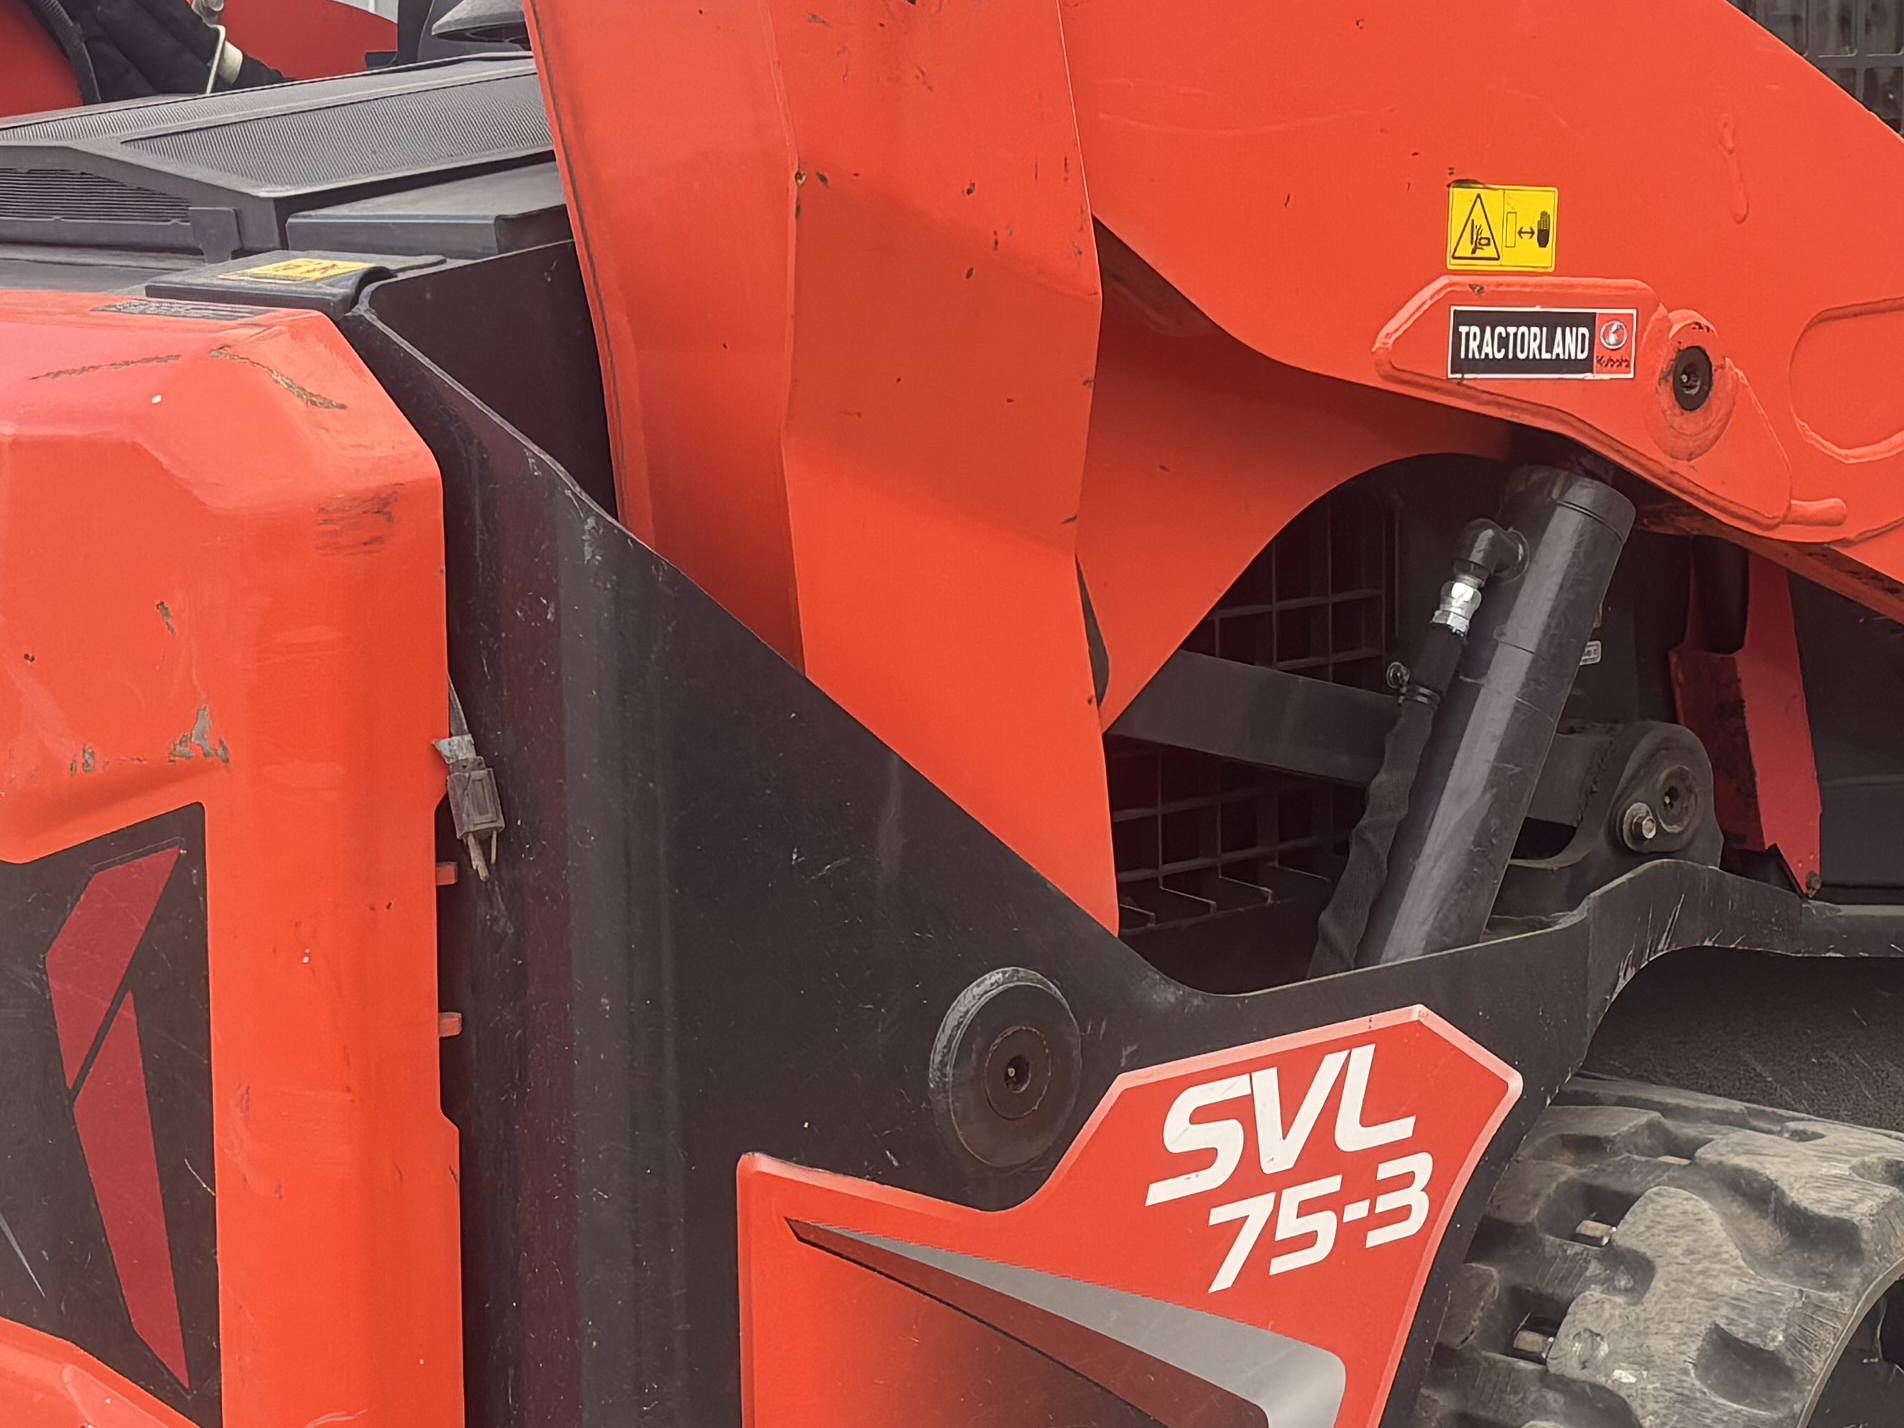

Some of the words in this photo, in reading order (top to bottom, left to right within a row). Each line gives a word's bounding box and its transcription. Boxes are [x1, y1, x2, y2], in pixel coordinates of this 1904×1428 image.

[1458, 325, 1590, 360] TRACTORLAND
[1144, 1043, 1416, 1207] SVL
[1208, 1152, 1434, 1294] 75-3
